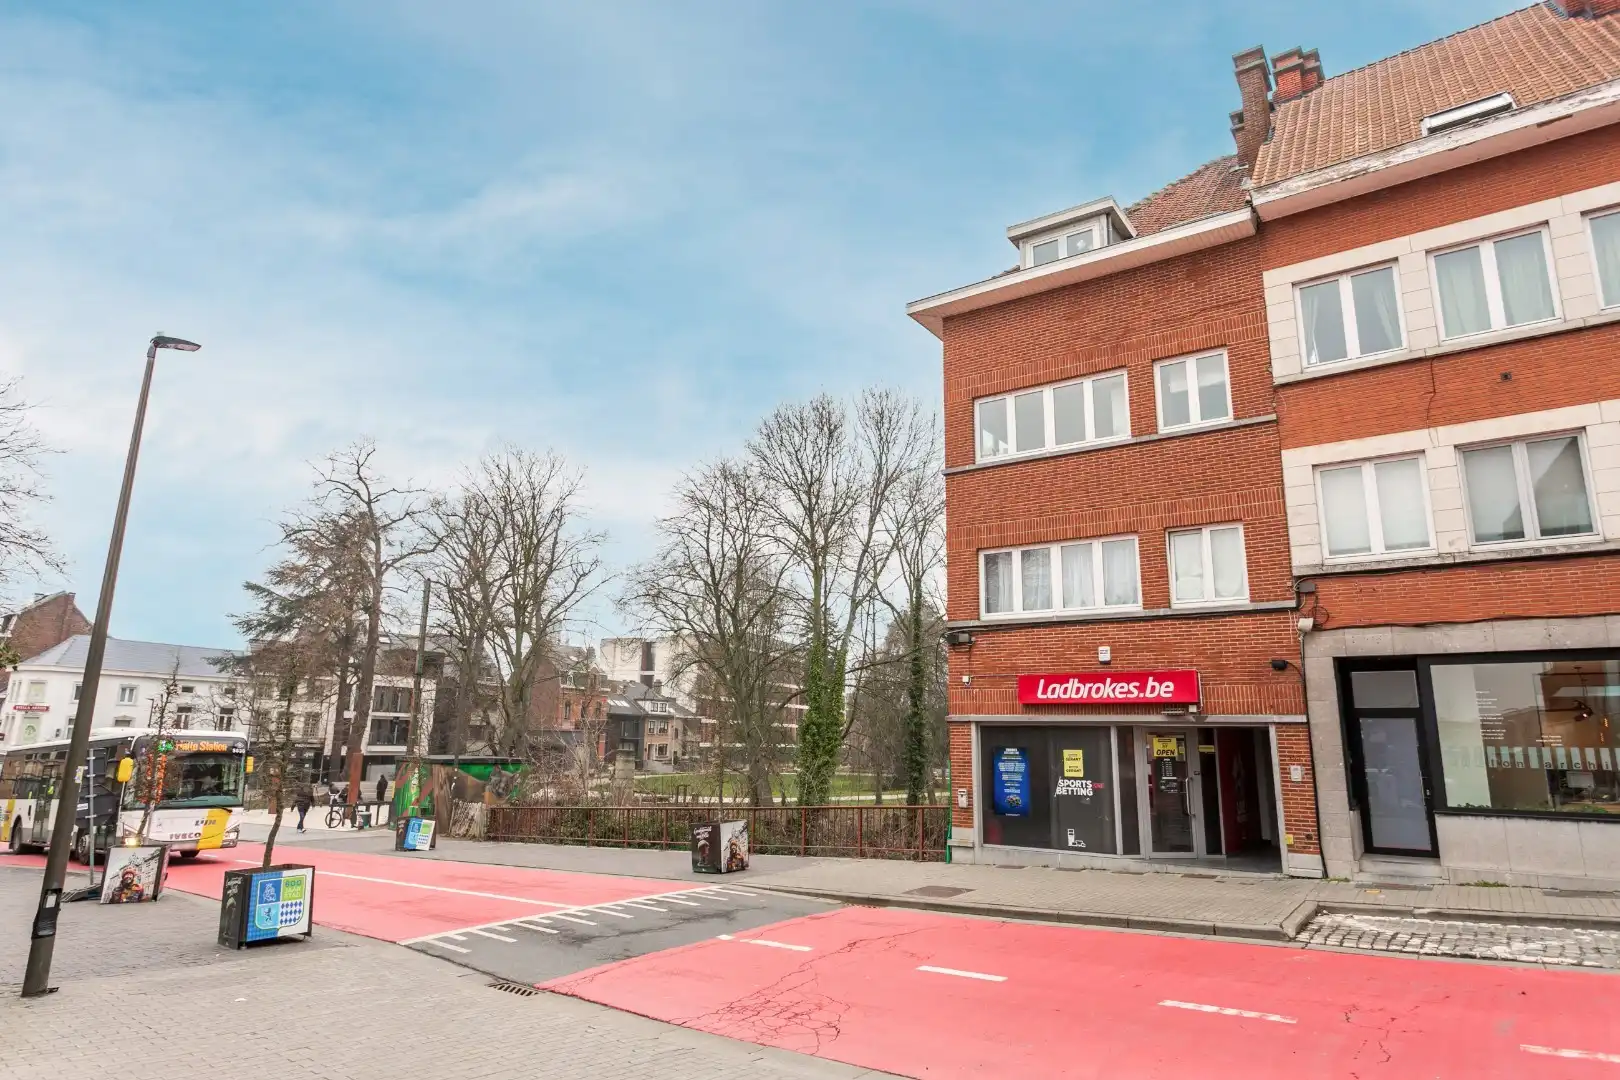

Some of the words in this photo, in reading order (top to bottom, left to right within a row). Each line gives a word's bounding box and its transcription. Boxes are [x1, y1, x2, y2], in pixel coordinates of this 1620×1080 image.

[1036, 676, 1175, 700] Ladbrokes.be
[199, 739, 228, 753] Station
[1058, 779, 1093, 788] SPORTS
[1056, 787, 1094, 797] BETTING
[169, 832, 202, 840] IVECO
